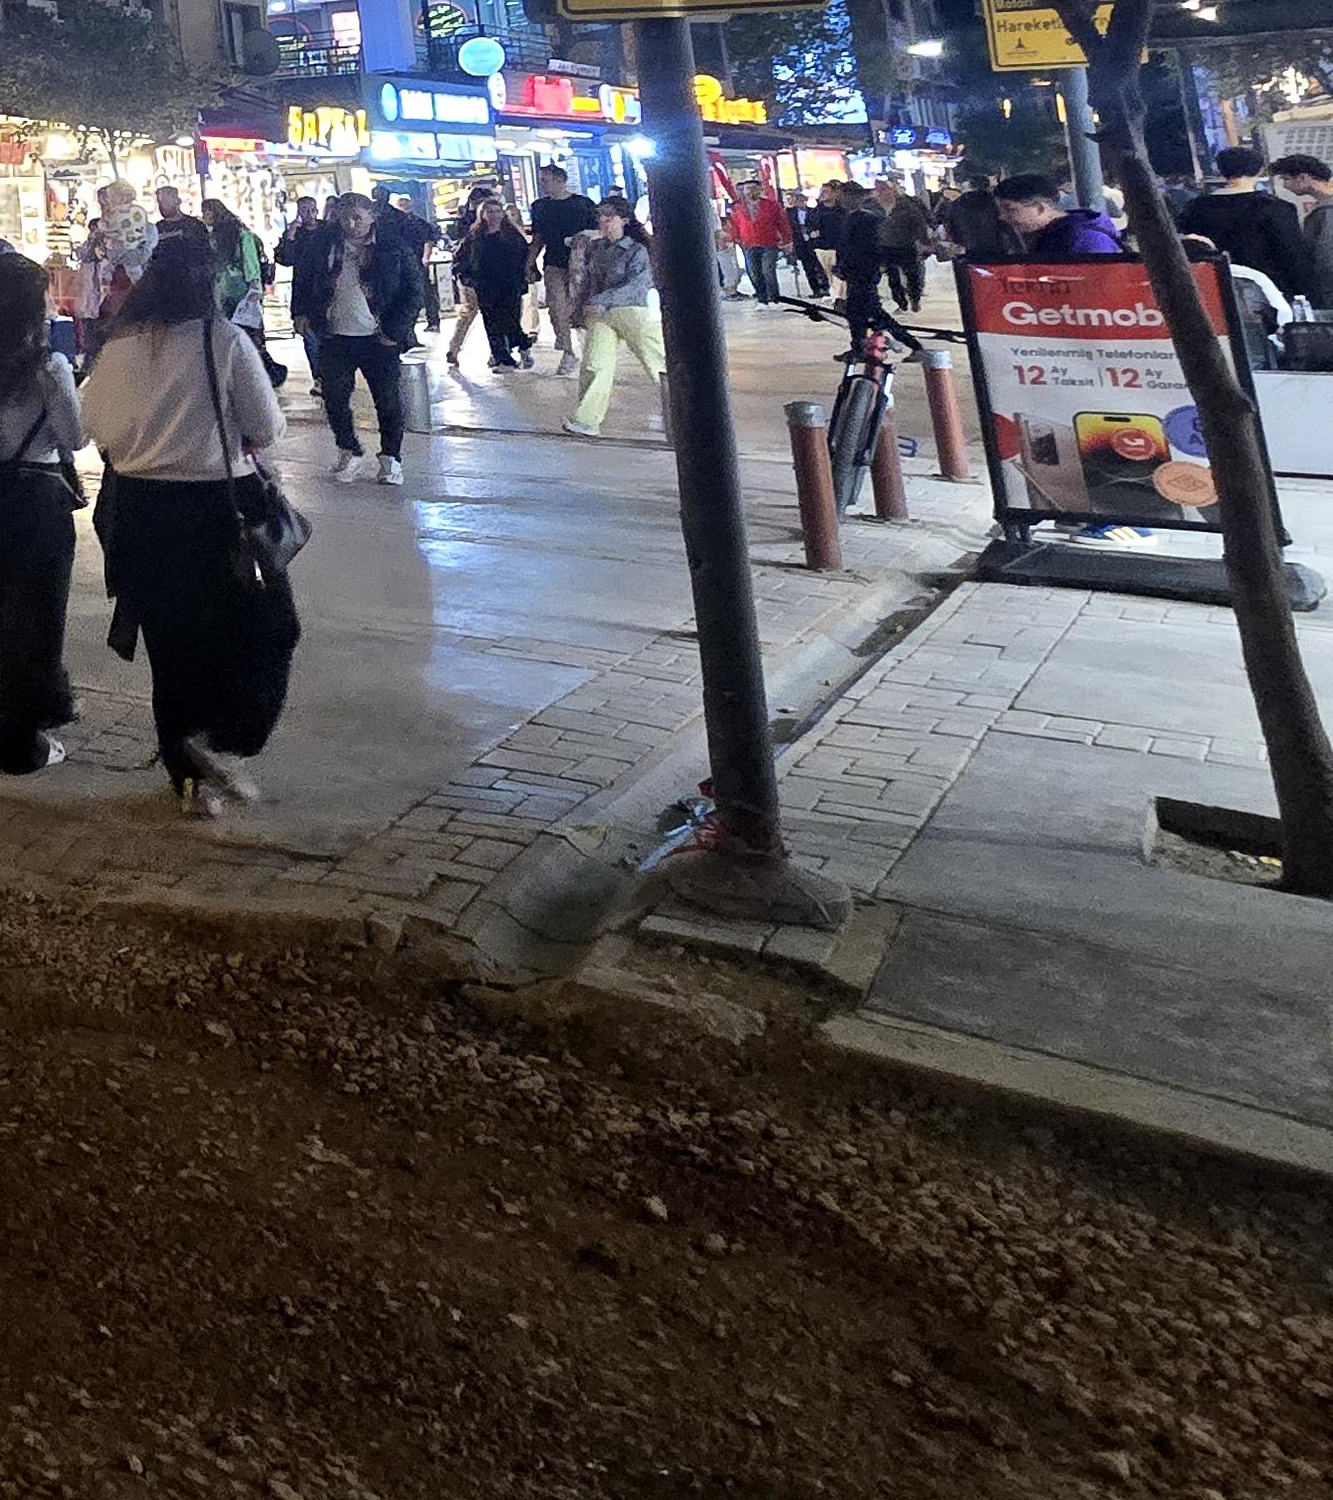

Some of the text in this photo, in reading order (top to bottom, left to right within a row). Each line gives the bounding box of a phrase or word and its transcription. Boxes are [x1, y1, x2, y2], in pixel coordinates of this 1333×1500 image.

[1002, 301, 1164, 327] Getmob
[1010, 347, 1094, 361] Yenilenmiş
[1013, 364, 1047, 385] 12
[1050, 365, 1069, 376] Ay
[1144, 368, 1163, 379] Ay
[1051, 377, 1094, 387] Taksit
[1105, 367, 1142, 389] 12
